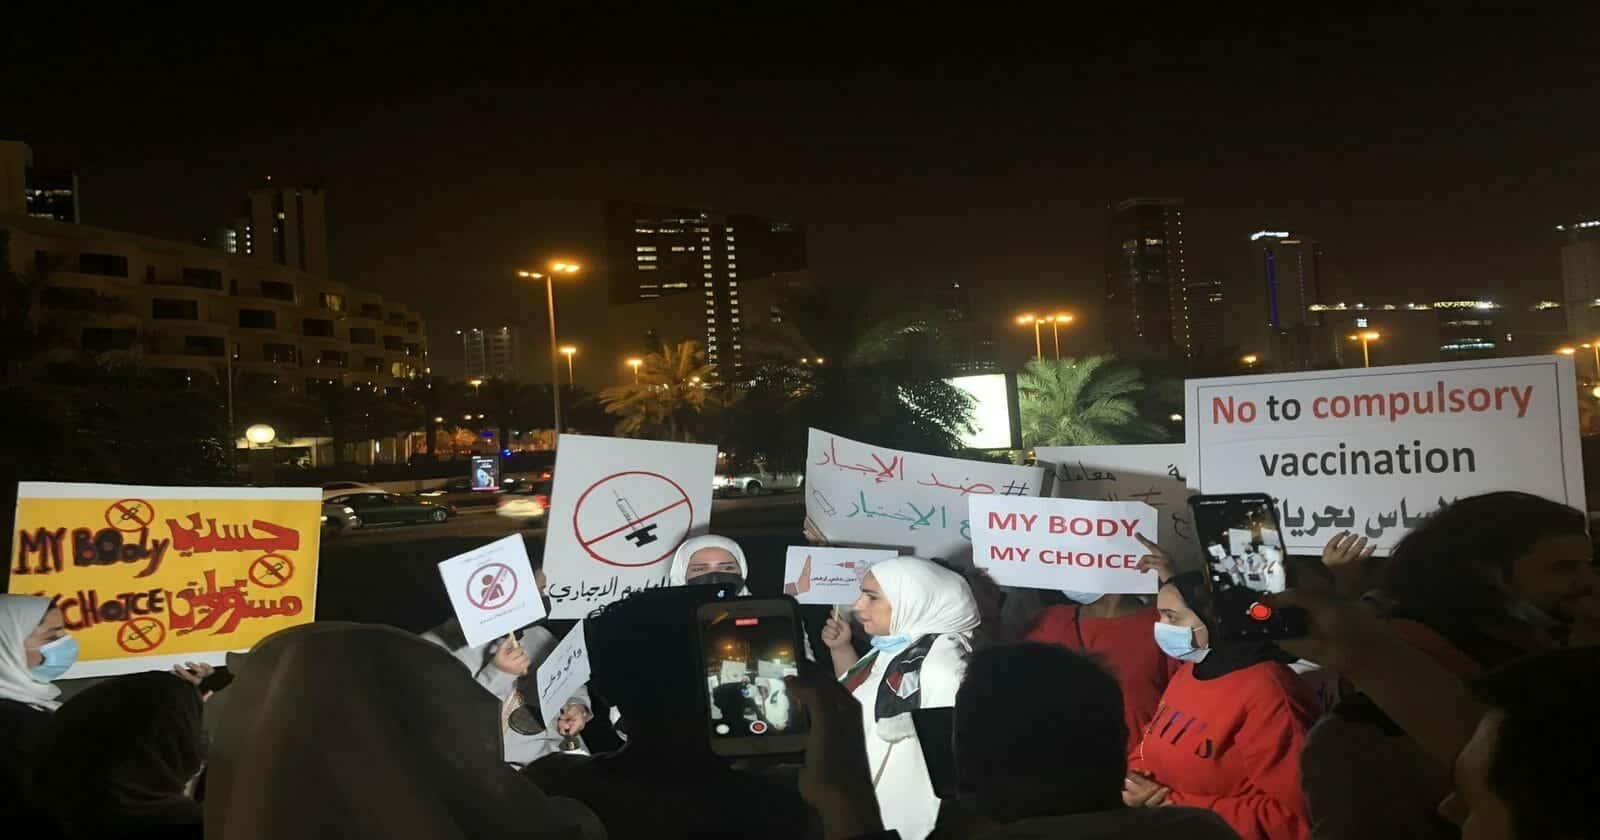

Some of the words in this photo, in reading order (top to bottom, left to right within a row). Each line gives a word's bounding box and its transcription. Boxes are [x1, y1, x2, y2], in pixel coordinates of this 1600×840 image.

[1211, 395, 1257, 425] No
[1265, 394, 1302, 422] to
[1311, 379, 1534, 423] compulsory
[1259, 439, 1476, 477] vaccination
[987, 510, 1039, 533] MY
[1048, 515, 1141, 538] BODY
[12, 526, 66, 576] MY
[989, 545, 1031, 563] MY
[1038, 549, 1138, 570] CHOICE
